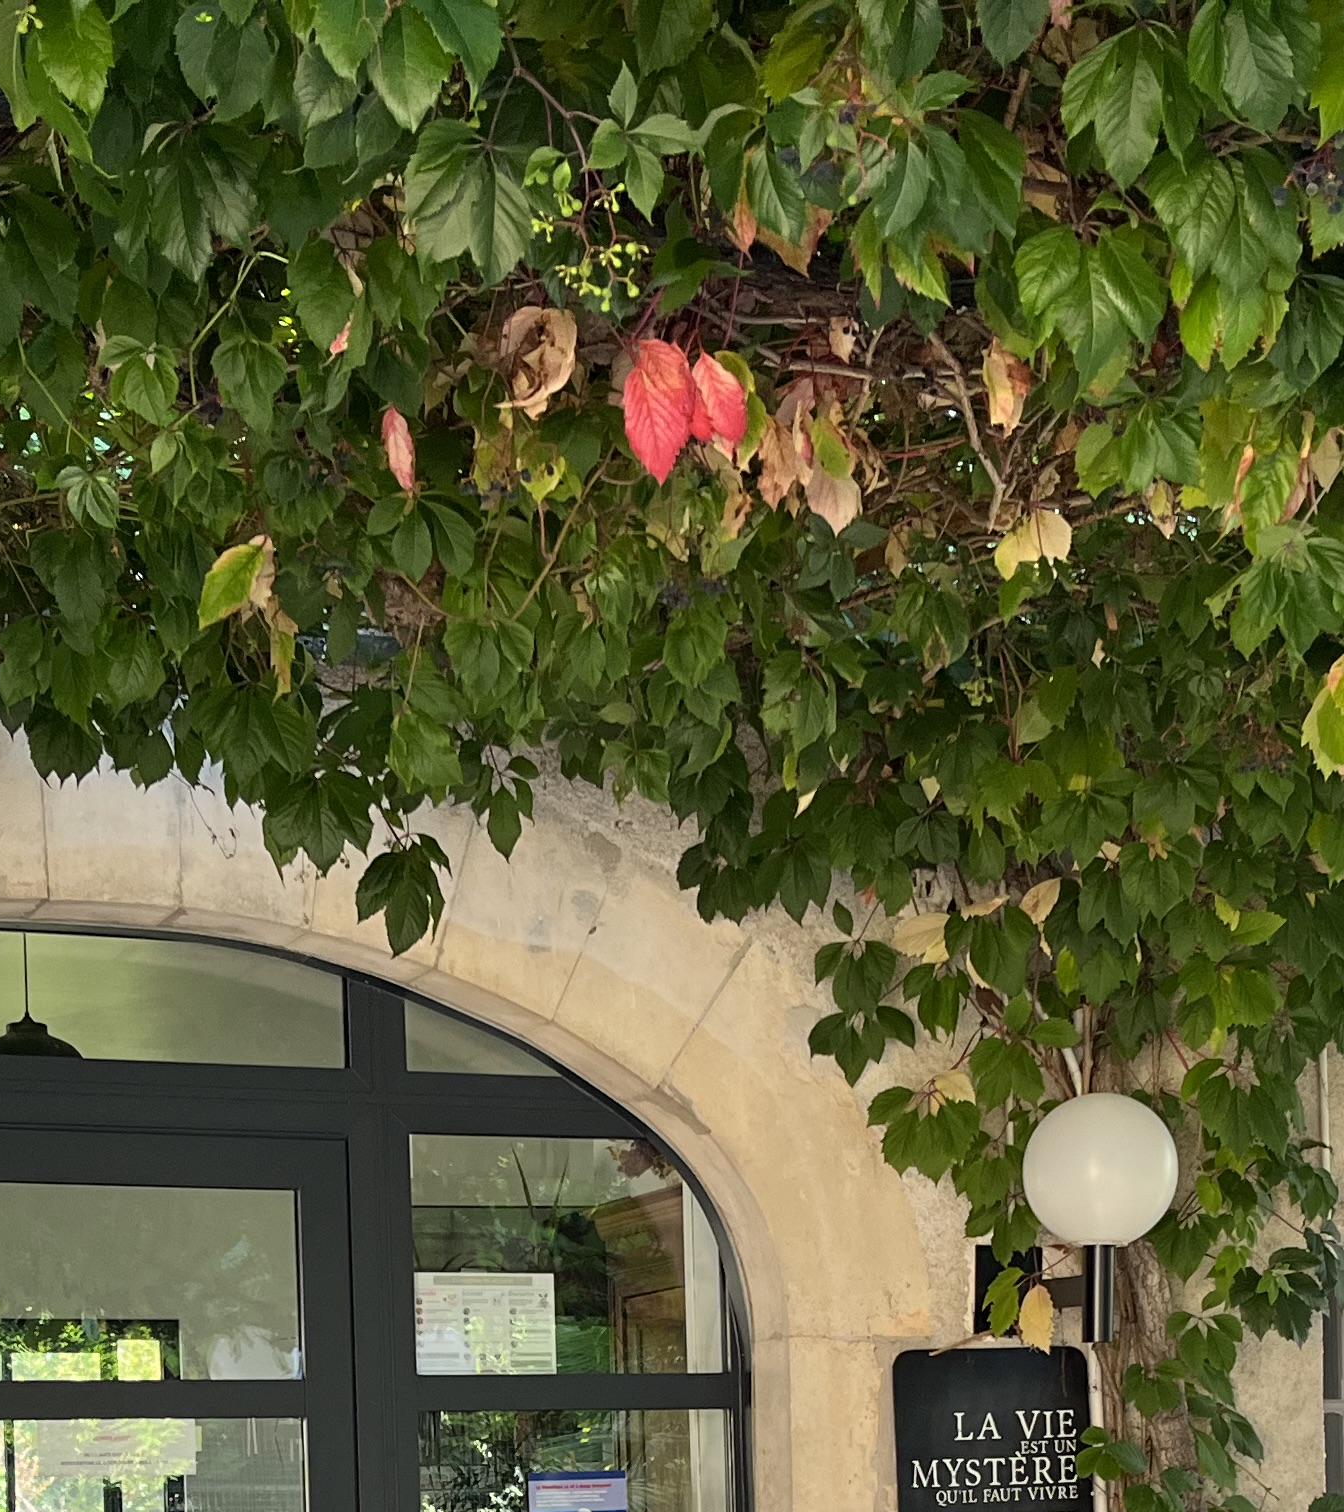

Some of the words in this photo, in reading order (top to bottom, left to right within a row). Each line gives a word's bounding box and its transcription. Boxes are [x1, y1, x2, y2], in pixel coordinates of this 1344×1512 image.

[953, 1411, 1002, 1441] LA
[1015, 1409, 1077, 1440] VIE
[1020, 1440, 1049, 1455] EST
[1054, 1439, 1077, 1454] UN
[911, 1450, 1078, 1489] MYSTÈRE
[936, 1489, 978, 1507] QU'IL
[983, 1487, 1023, 1503] FAUT
[1027, 1485, 1079, 1501] VIVRE
